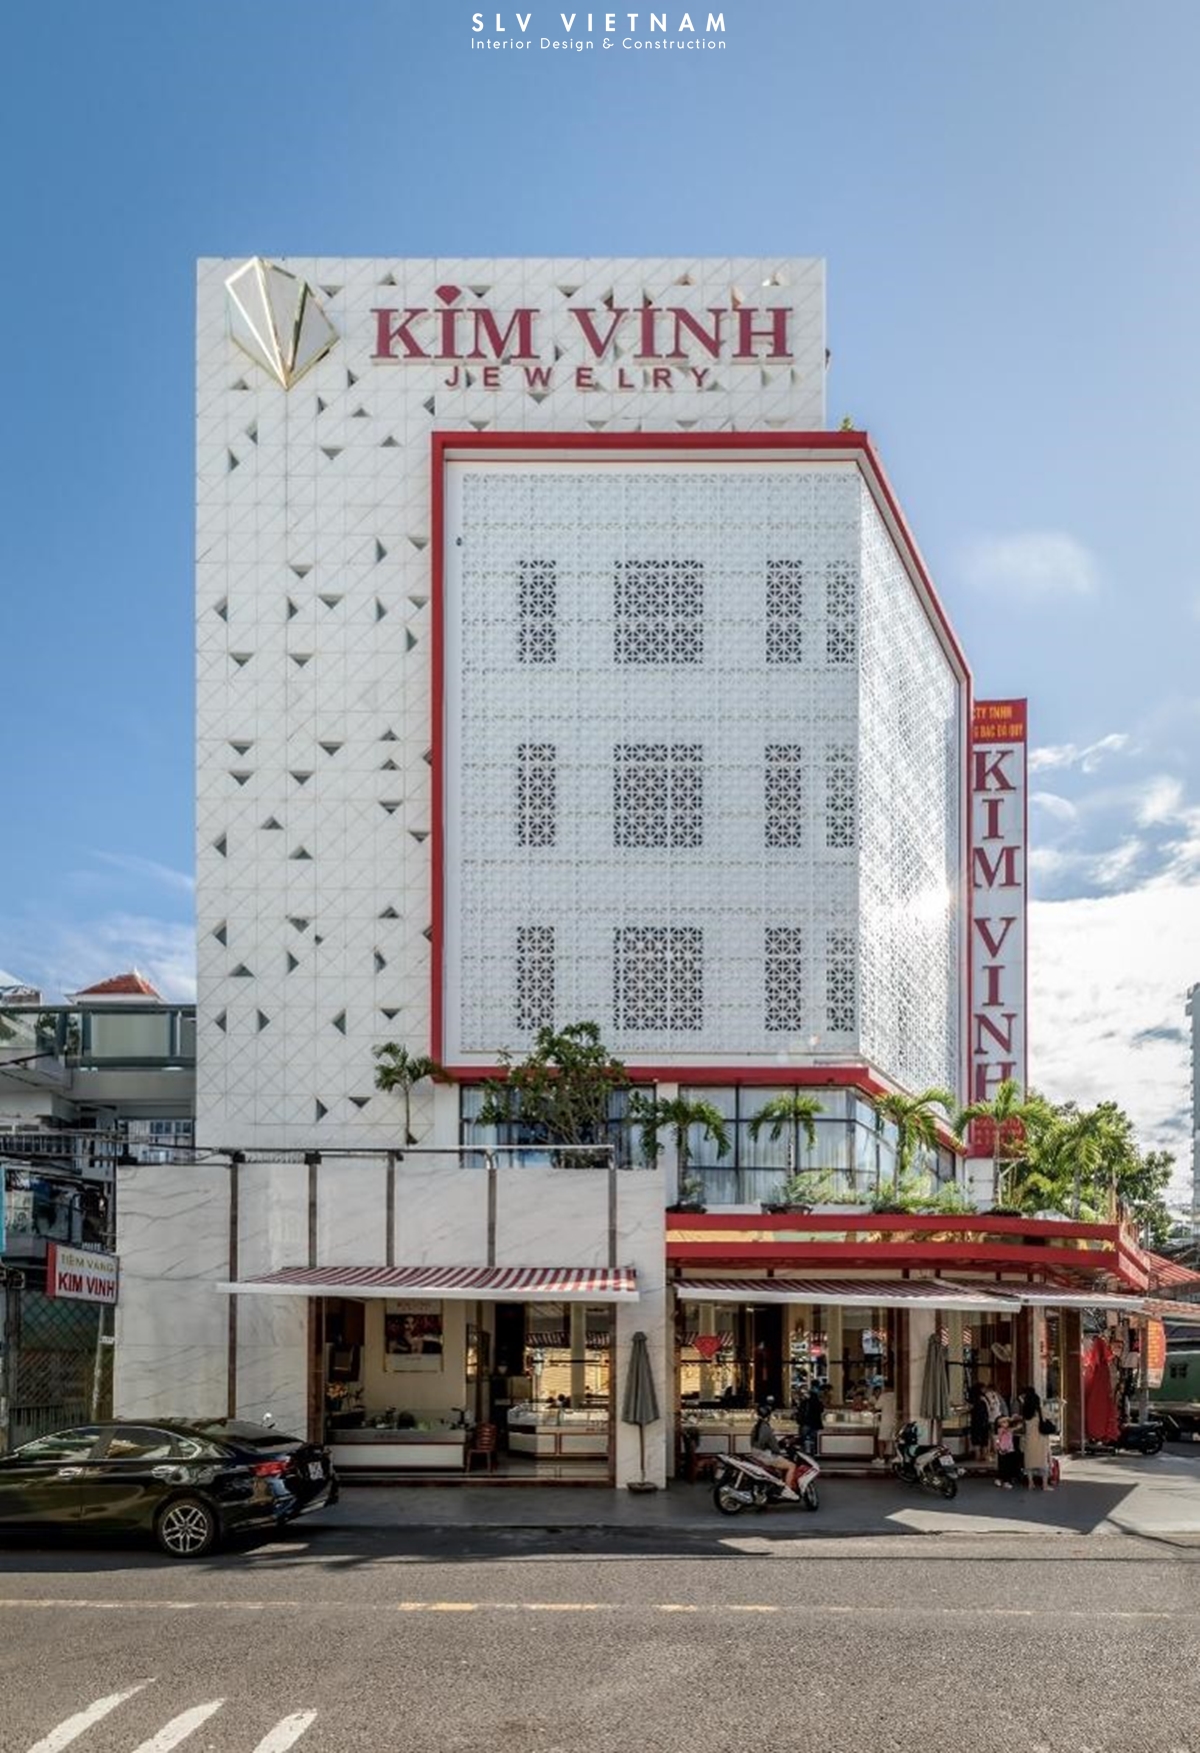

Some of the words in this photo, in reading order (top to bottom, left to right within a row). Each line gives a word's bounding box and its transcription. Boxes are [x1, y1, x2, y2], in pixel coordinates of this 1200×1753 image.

[369, 304, 541, 359] KIM
[567, 307, 793, 359] VINH
[444, 365, 709, 389] JEWELRY
[973, 749, 1021, 888] KIM
[58, 1271, 83, 1293] KIM
[86, 1276, 115, 1298] VINH
